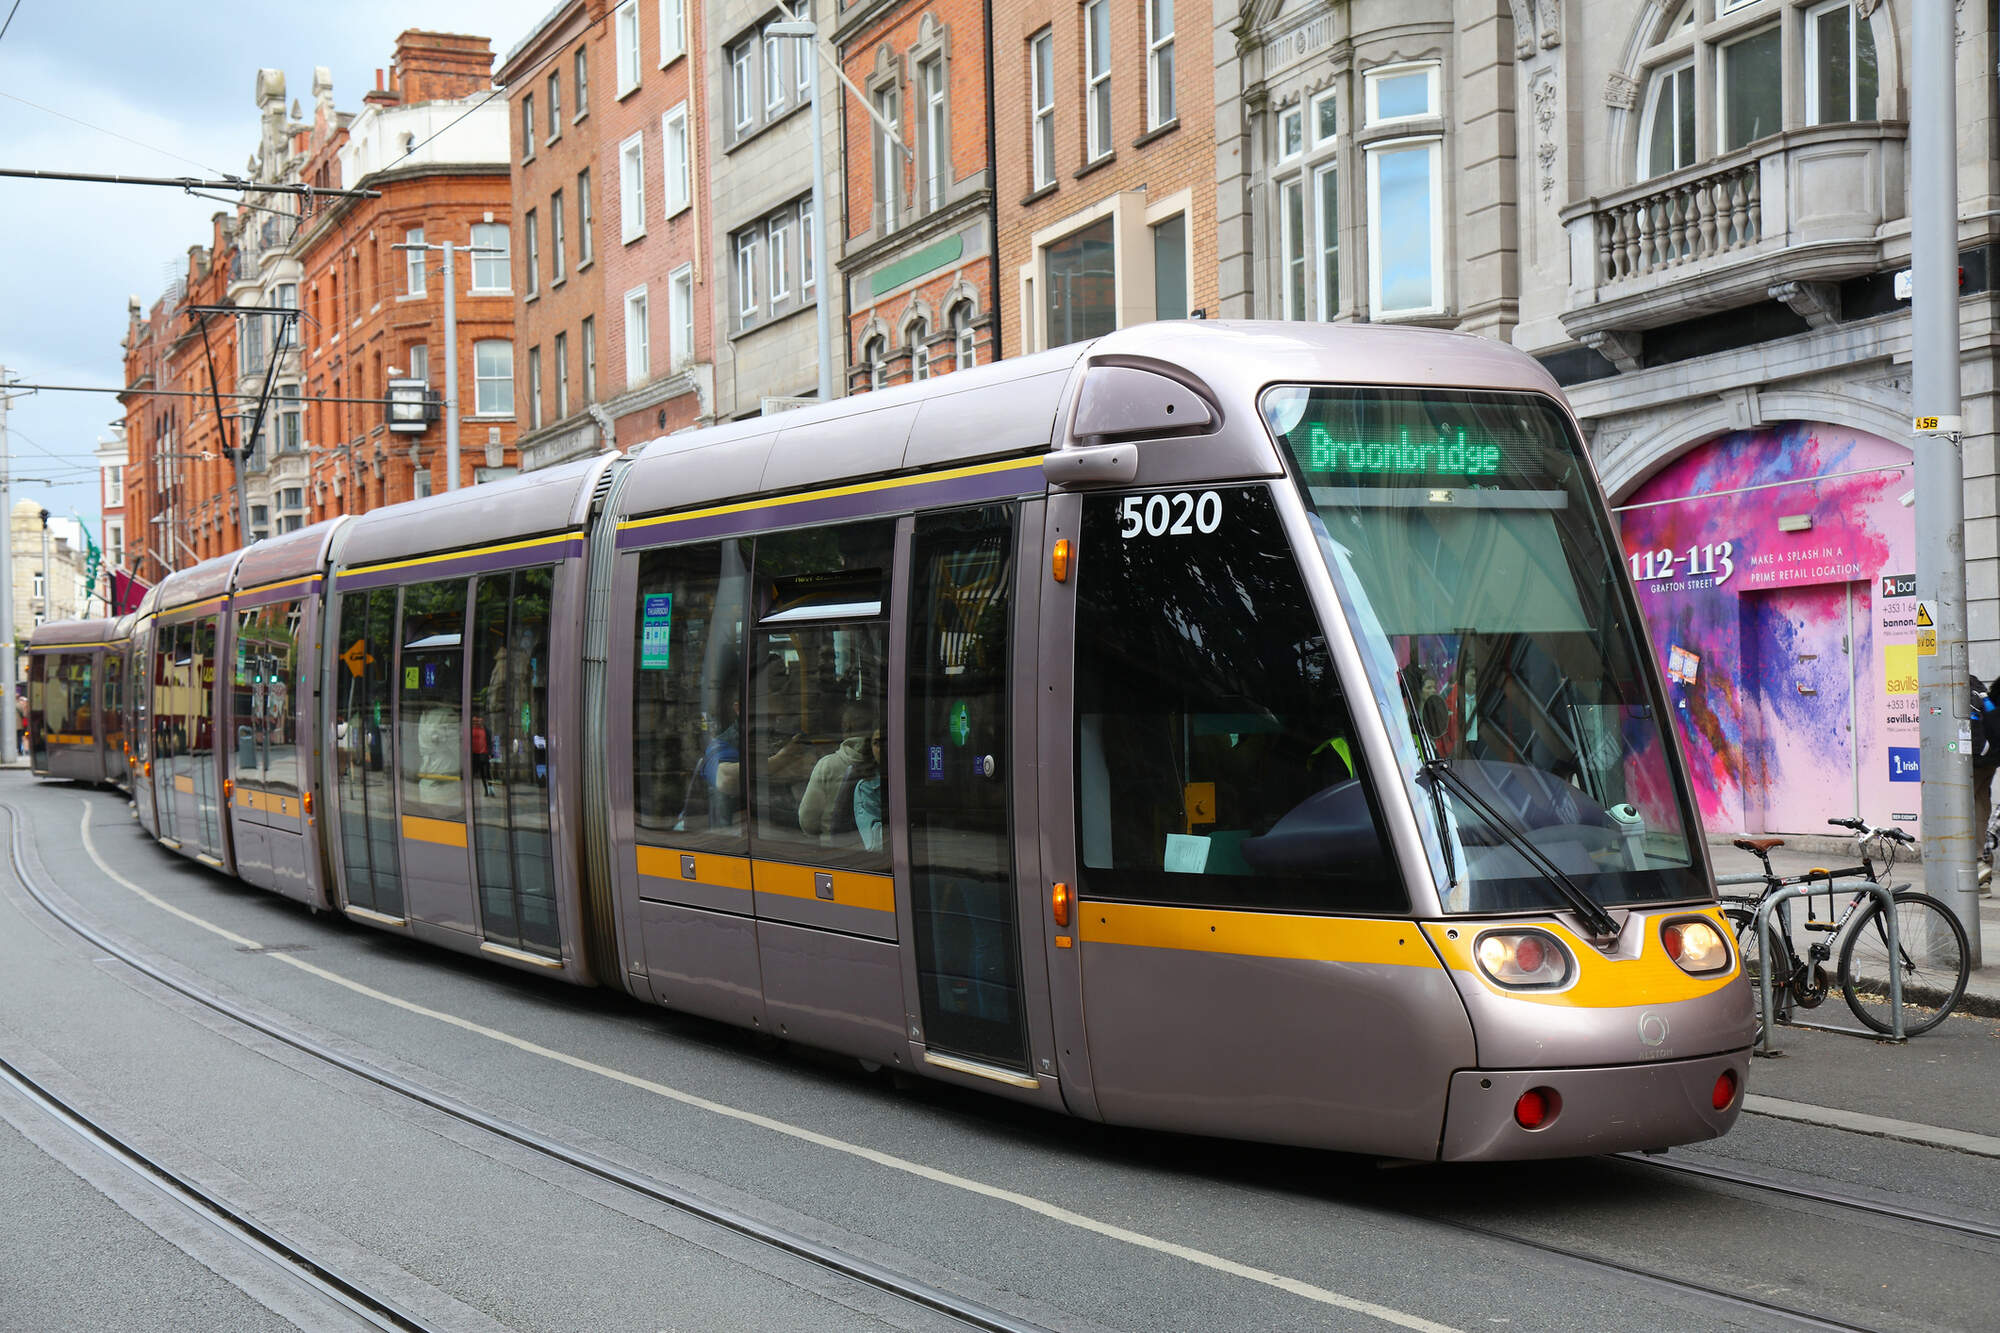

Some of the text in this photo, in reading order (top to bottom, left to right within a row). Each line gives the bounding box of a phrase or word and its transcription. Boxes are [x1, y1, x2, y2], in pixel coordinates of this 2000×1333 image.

[1121, 490, 1223, 539] 5020
[1628, 540, 1735, 586] 112-113
[1751, 546, 1844, 566] MAKE A SPLASH IN A
[1751, 563, 1860, 583] PRIME RETAIL LOCATION
[1650, 578, 1713, 594] GRAFTON STREET
[1882, 603, 1900, 614] +353
[1887, 675, 1919, 692] savills
[1887, 699, 1904, 710] +353
[1903, 761, 1919, 771] Irish
